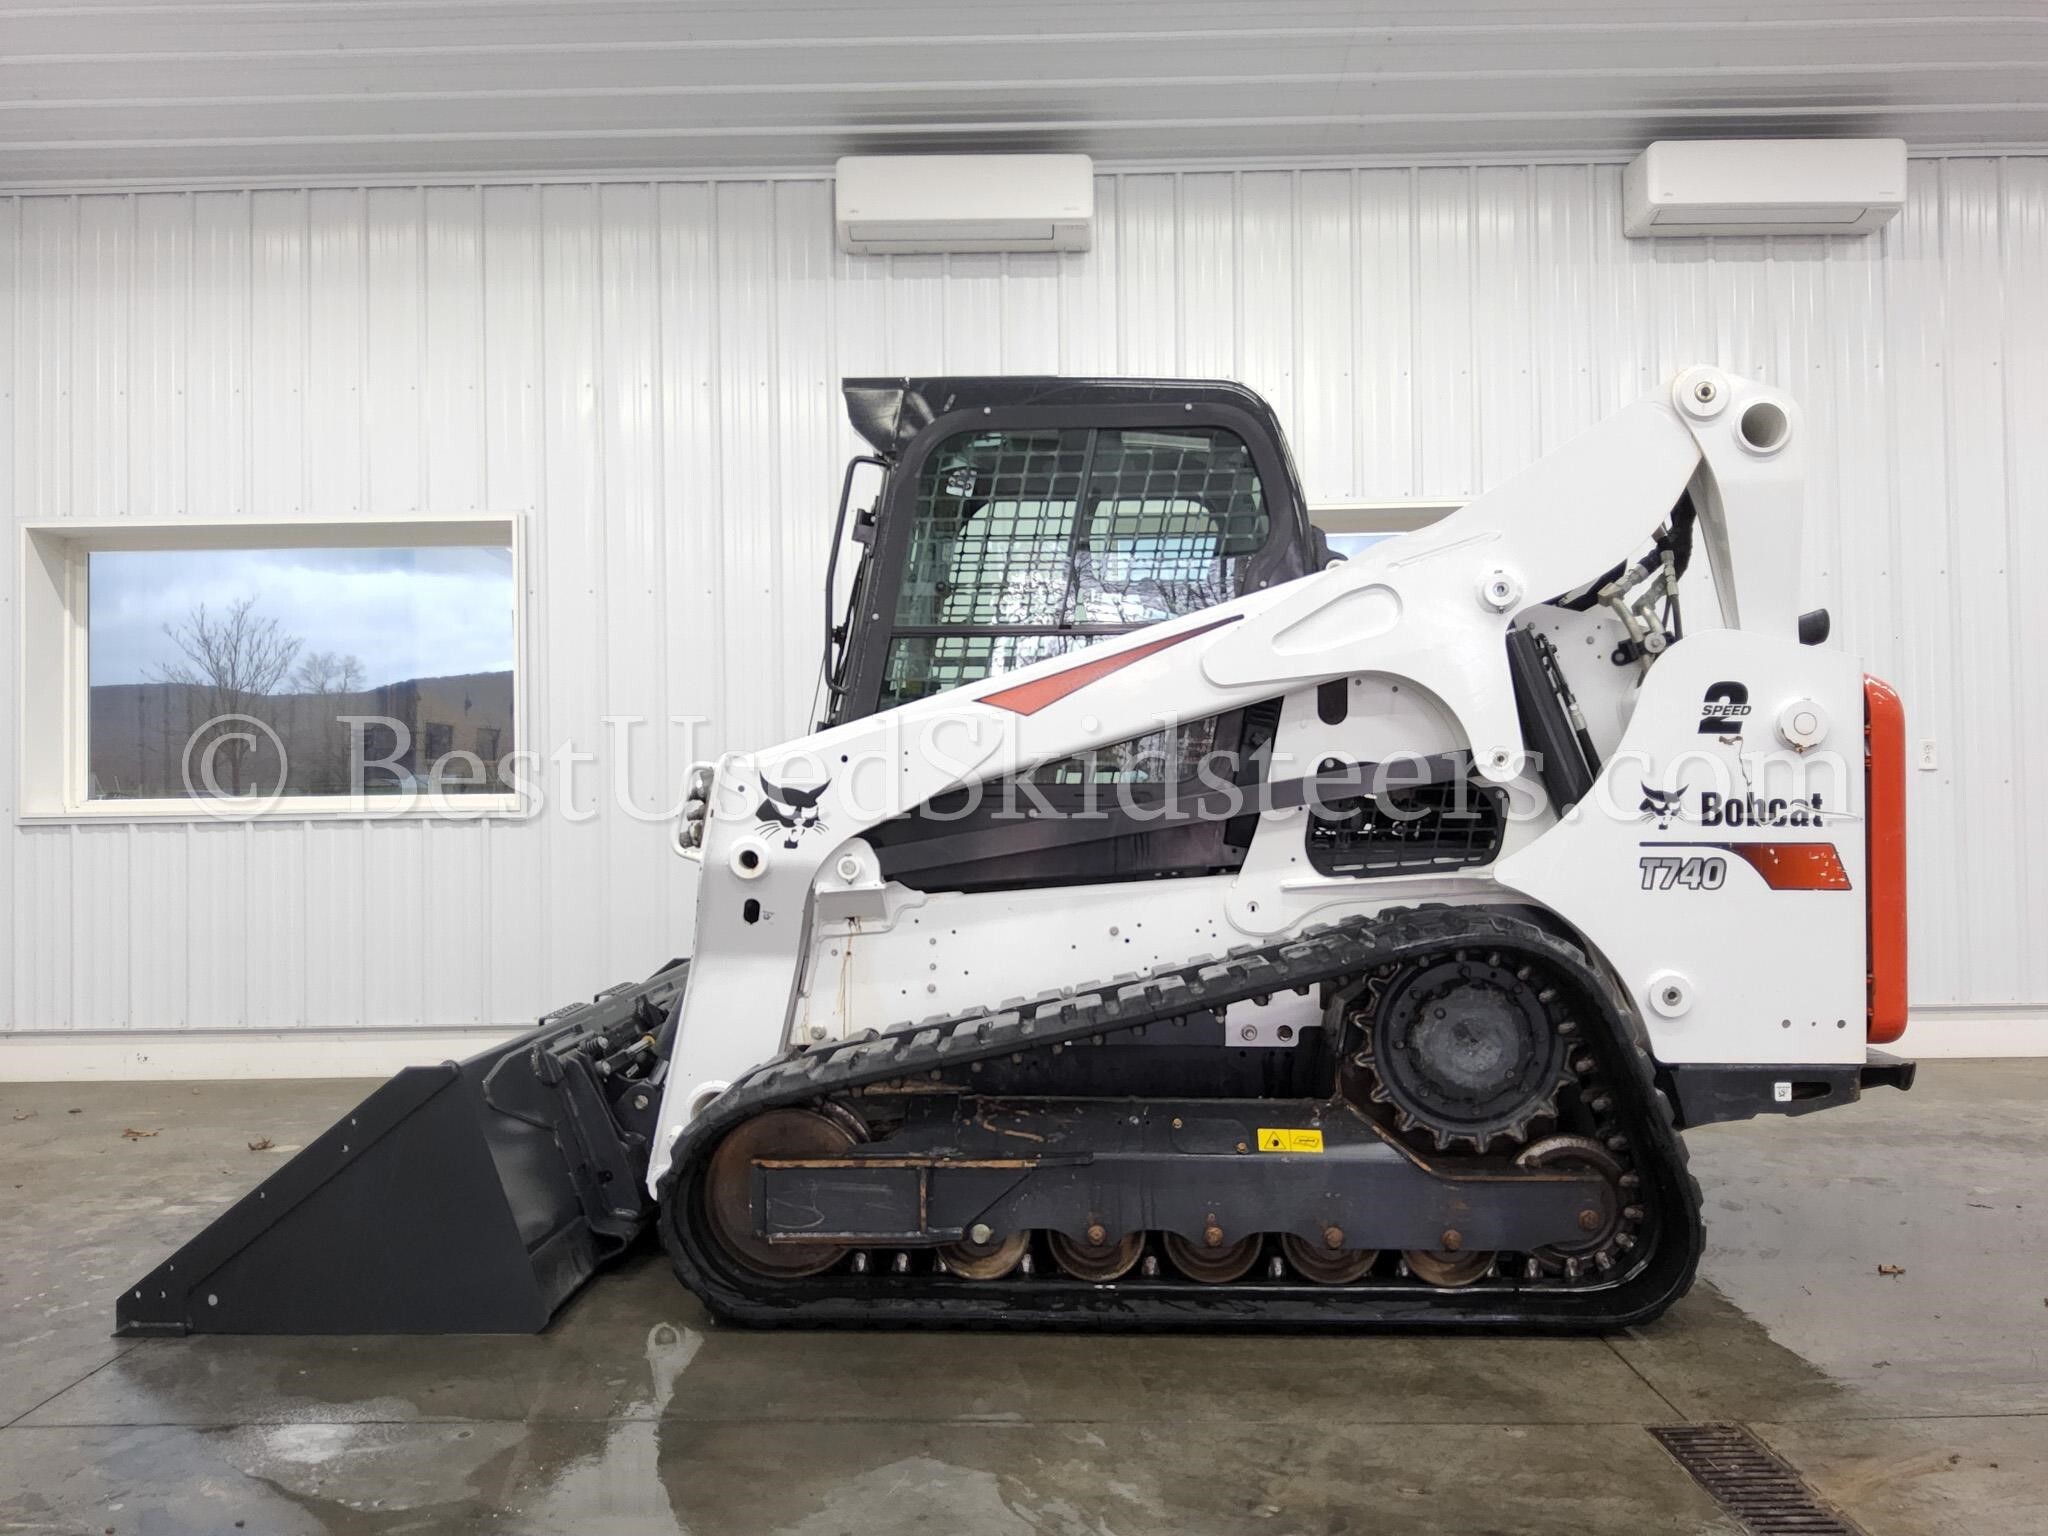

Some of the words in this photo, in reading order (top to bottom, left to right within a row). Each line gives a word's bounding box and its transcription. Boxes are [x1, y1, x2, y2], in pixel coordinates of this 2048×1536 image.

[1697, 680, 1749, 734] 2
[1701, 704, 1752, 716] SPEED
[1701, 791, 1823, 827] Bobcat
[1639, 857, 1727, 890] T740
